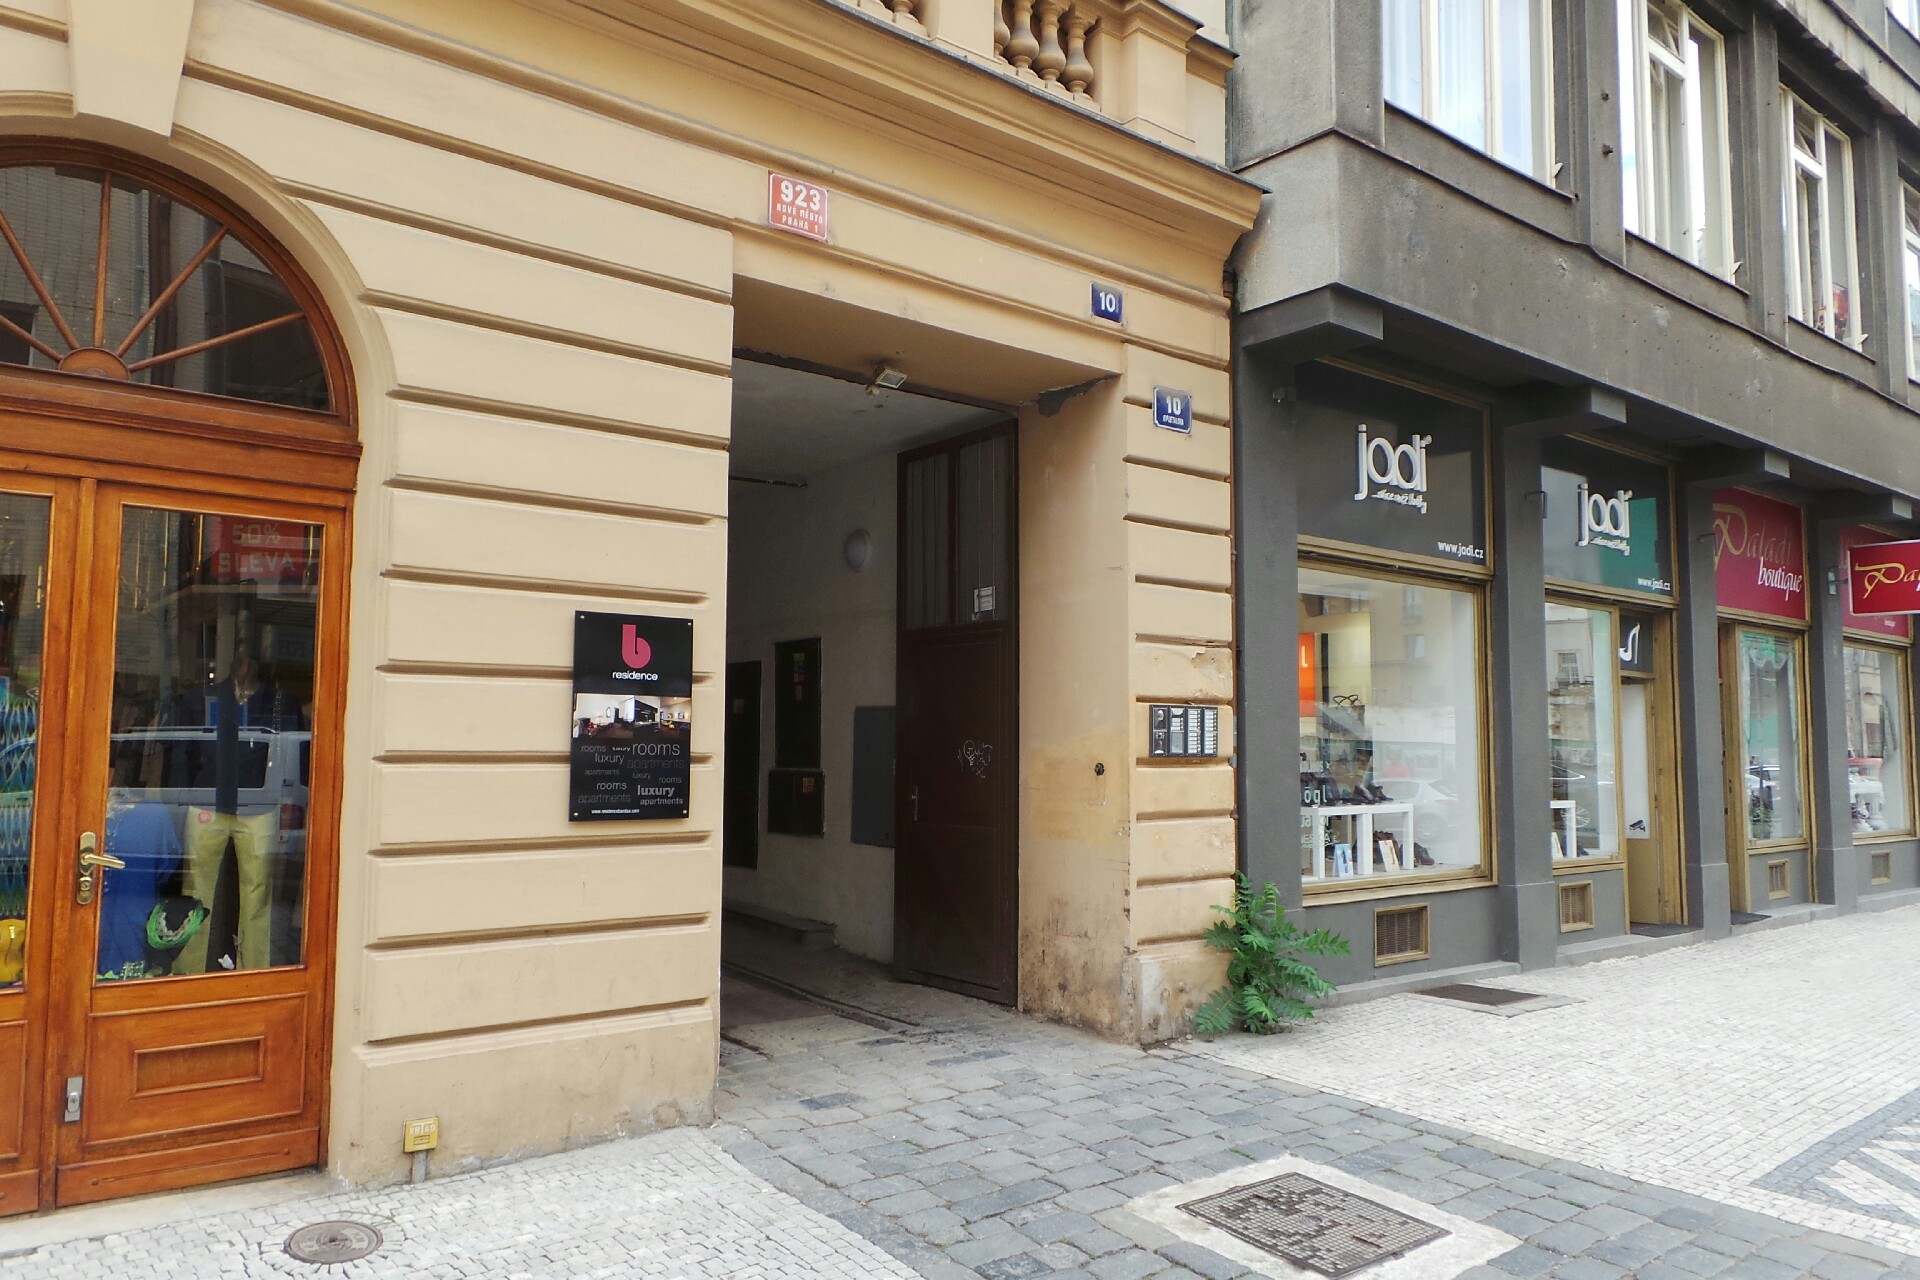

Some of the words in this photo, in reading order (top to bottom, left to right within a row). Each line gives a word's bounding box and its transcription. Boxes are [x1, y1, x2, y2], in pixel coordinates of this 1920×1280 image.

[781, 181, 820, 211] 923
[777, 203, 797, 215] NOVÉ
[782, 215, 809, 230] PRAHA
[815, 225, 818, 233] 1
[1099, 291, 1116, 313] 10
[1166, 396, 1182, 415] 10
[1354, 423, 1432, 500] jodi
[1576, 482, 1634, 547] jodi
[231, 522, 281, 544] 50%
[1437, 541, 1484, 559] www.jodi.cz
[218, 552, 296, 574] SLEVA
[1758, 556, 1803, 601] boutique
[612, 670, 659, 681] residence
[581, 744, 607, 753] rooms
[632, 742, 681, 756] rooms
[594, 753, 625, 765] luxury
[596, 781, 627, 791] rooms
[658, 776, 682, 784] rooms
[577, 793, 631, 804] apartments
[637, 784, 675, 798] luxury
[639, 797, 684, 807] apartments
